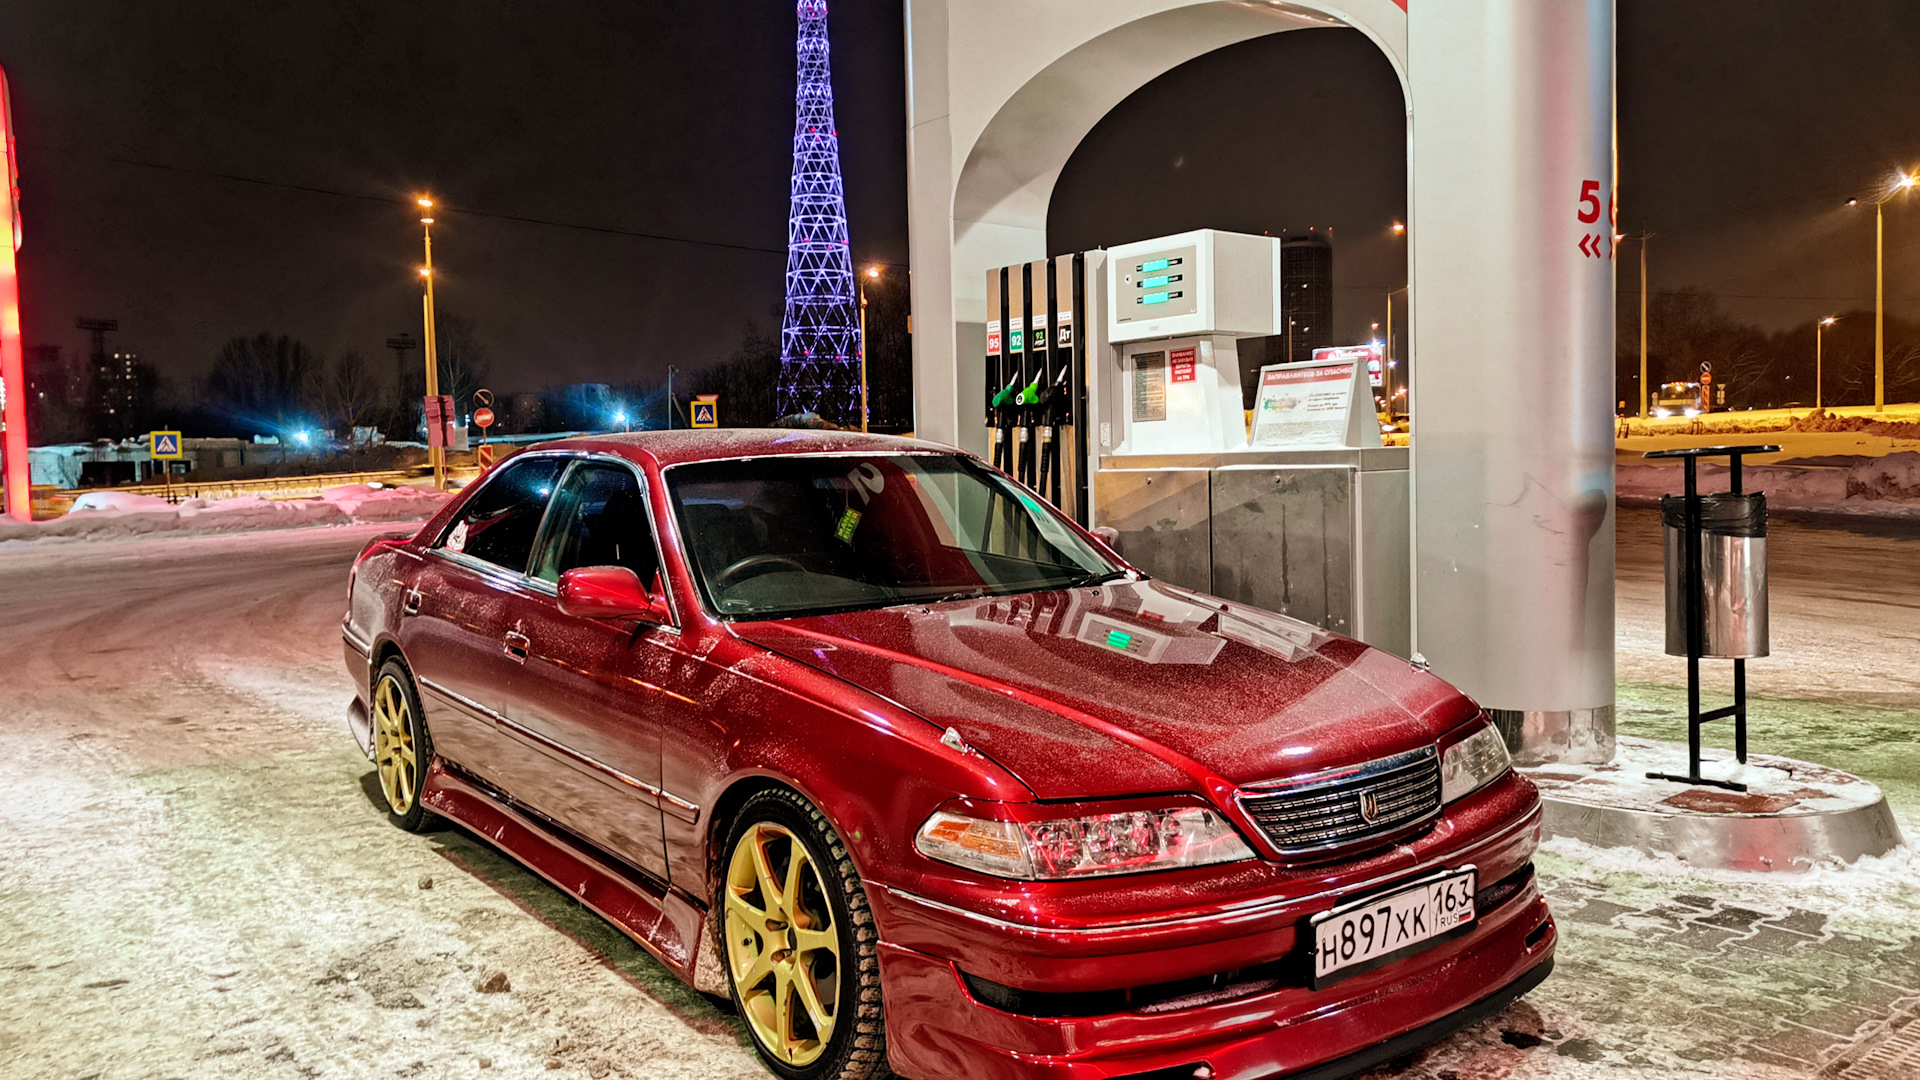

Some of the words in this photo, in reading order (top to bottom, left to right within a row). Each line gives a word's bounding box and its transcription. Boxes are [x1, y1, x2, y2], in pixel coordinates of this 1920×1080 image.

[1577, 180, 1601, 224] 5
[1011, 335, 1022, 346] 92
[1035, 331, 1044, 339] 92
[1059, 329, 1071, 341] Дт
[989, 338, 1000, 349] 95
[1266, 371, 1315, 381] ЗАПРАВЛЯЙТЕСЬ
[1324, 367, 1353, 376] СПАСИБО
[838, 509, 853, 537] MANN
[843, 512, 859, 540] FILTER
[1433, 878, 1469, 915] 163
[1440, 913, 1459, 927] RUS
